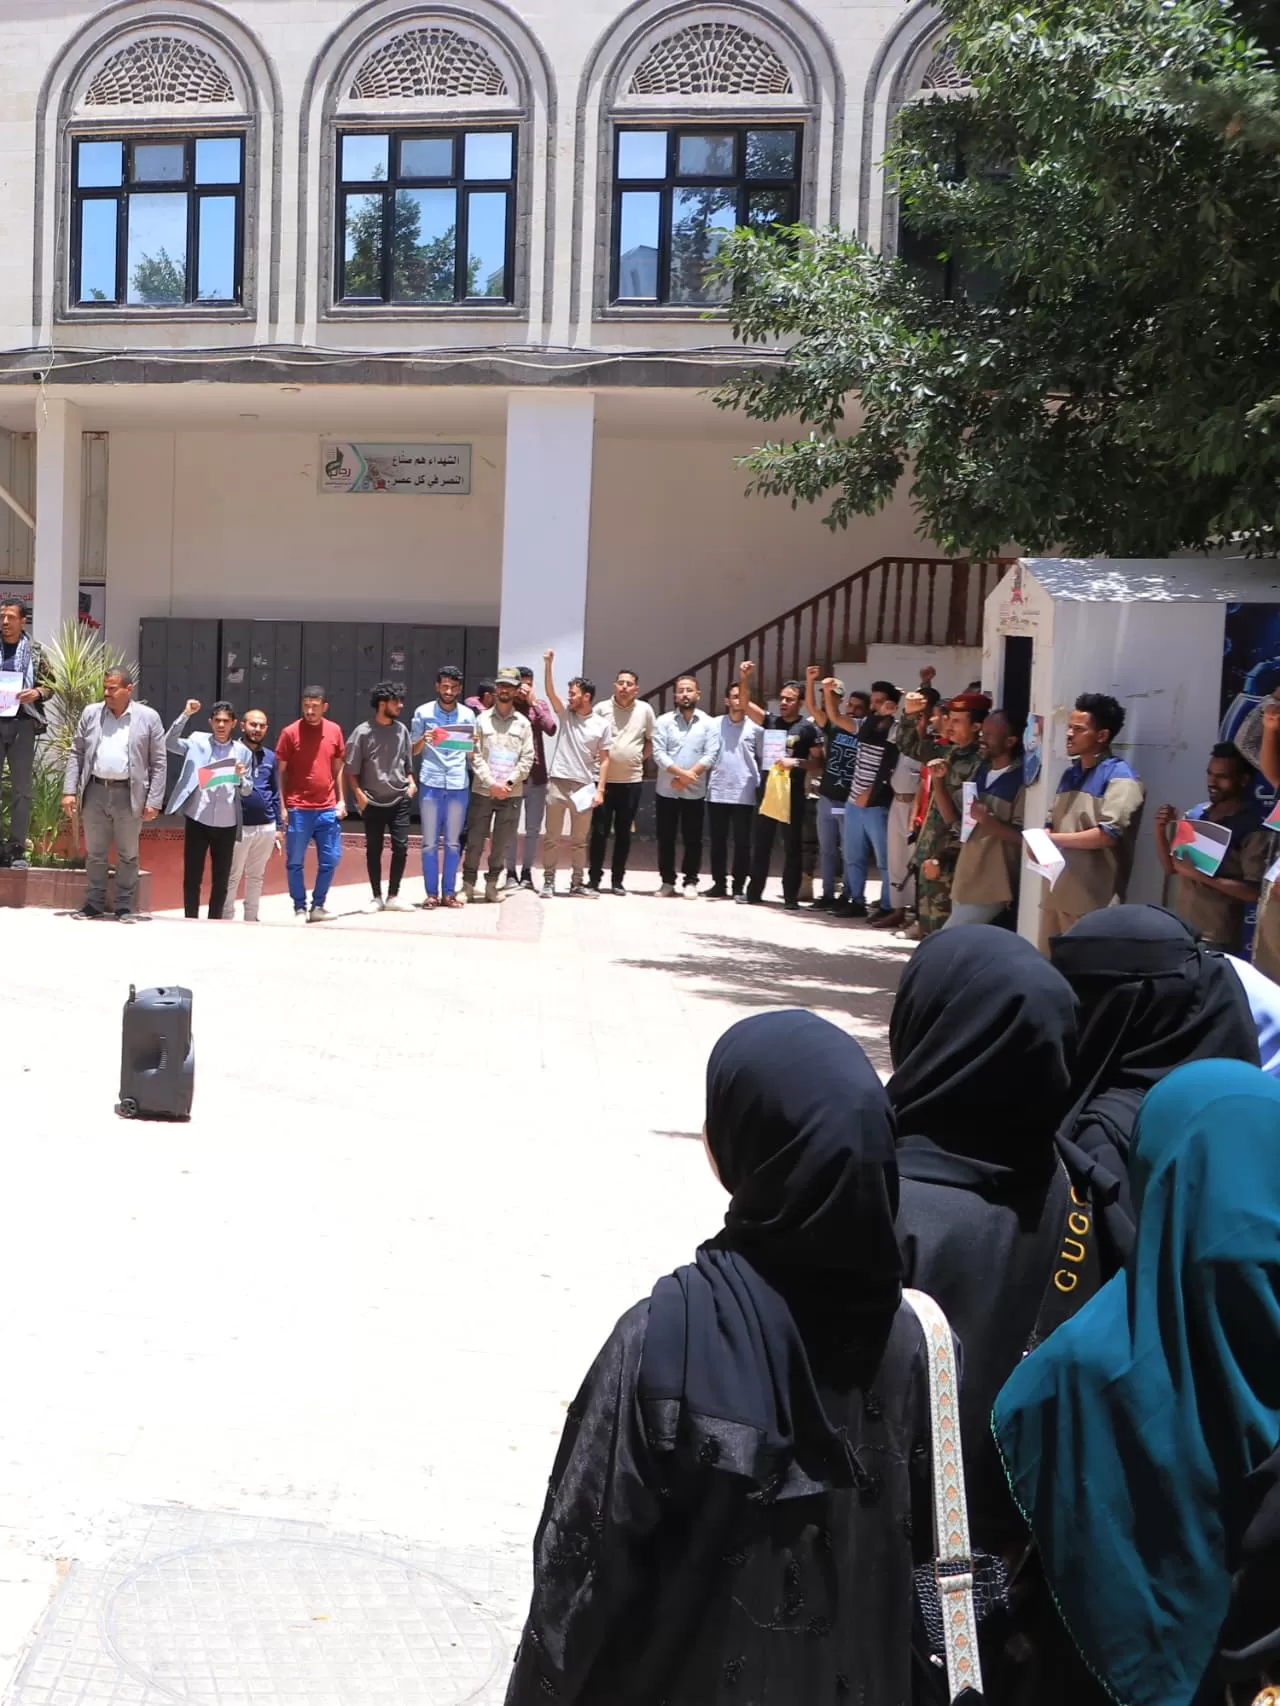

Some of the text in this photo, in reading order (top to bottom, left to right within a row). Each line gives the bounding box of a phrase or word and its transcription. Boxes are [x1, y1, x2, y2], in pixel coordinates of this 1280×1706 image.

[414, 456, 426, 466] هم
[428, 455, 460, 467] الشهداء
[414, 474, 425, 486] كل
[427, 474, 439, 488] في
[440, 474, 465, 486] النصر
